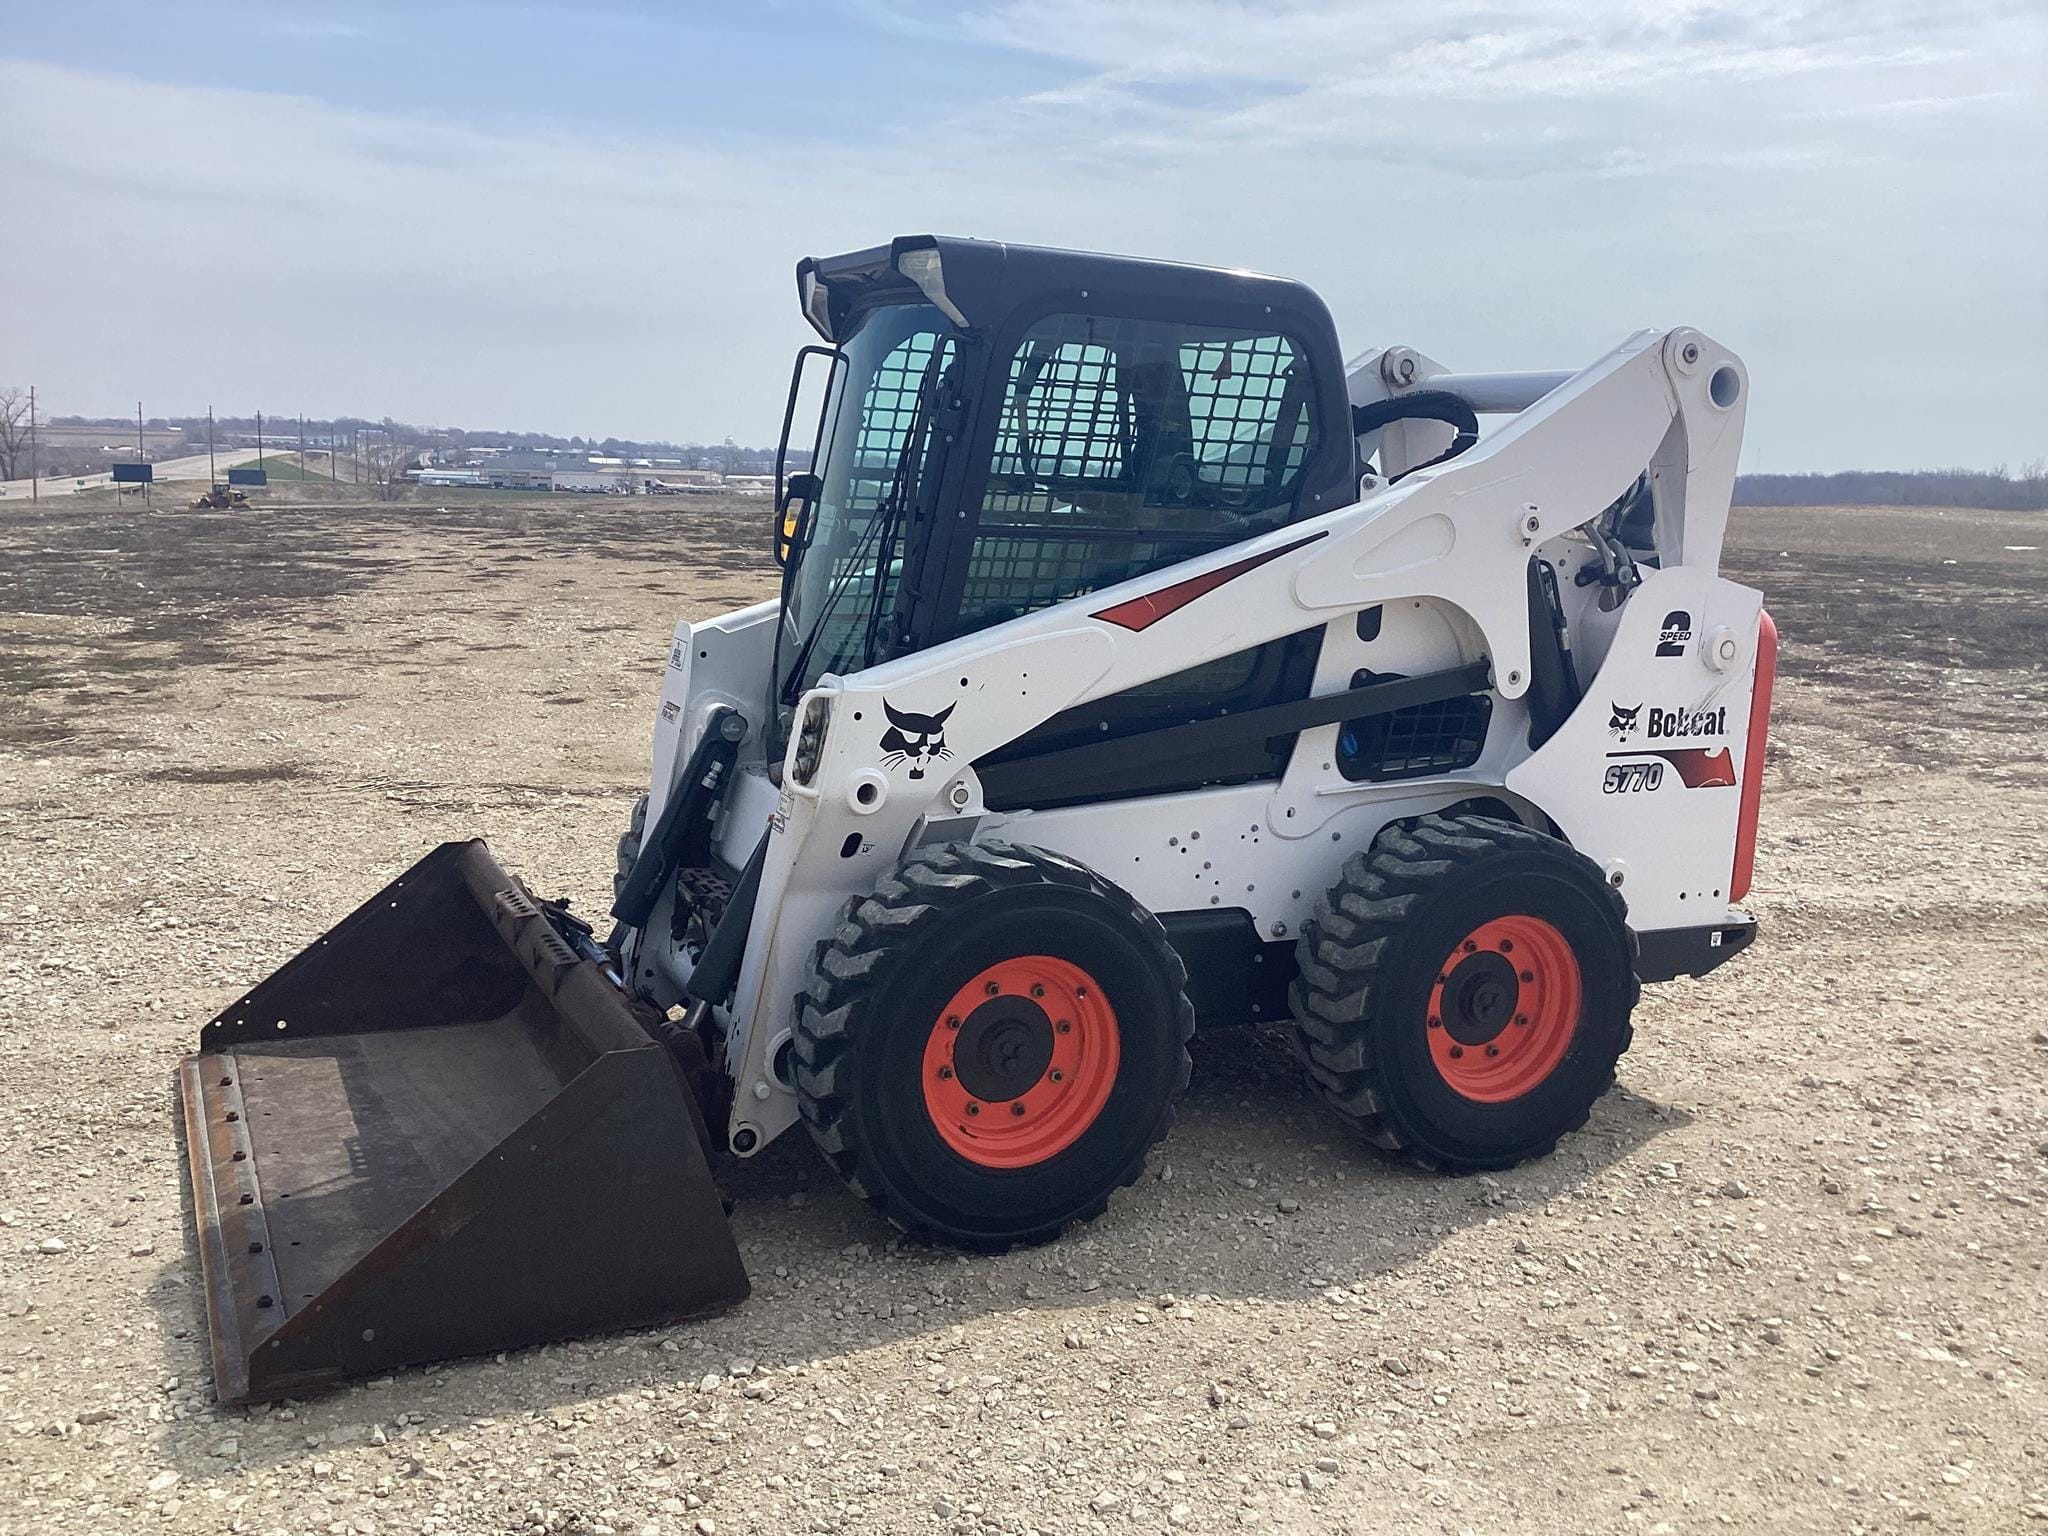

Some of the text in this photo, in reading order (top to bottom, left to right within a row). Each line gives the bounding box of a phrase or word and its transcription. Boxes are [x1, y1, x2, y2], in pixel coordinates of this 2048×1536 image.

[1655, 610, 1691, 657] 2
[1659, 631, 1692, 641] SPEED
[1647, 706, 1726, 738] Bobcat
[1603, 763, 1664, 794] S770
